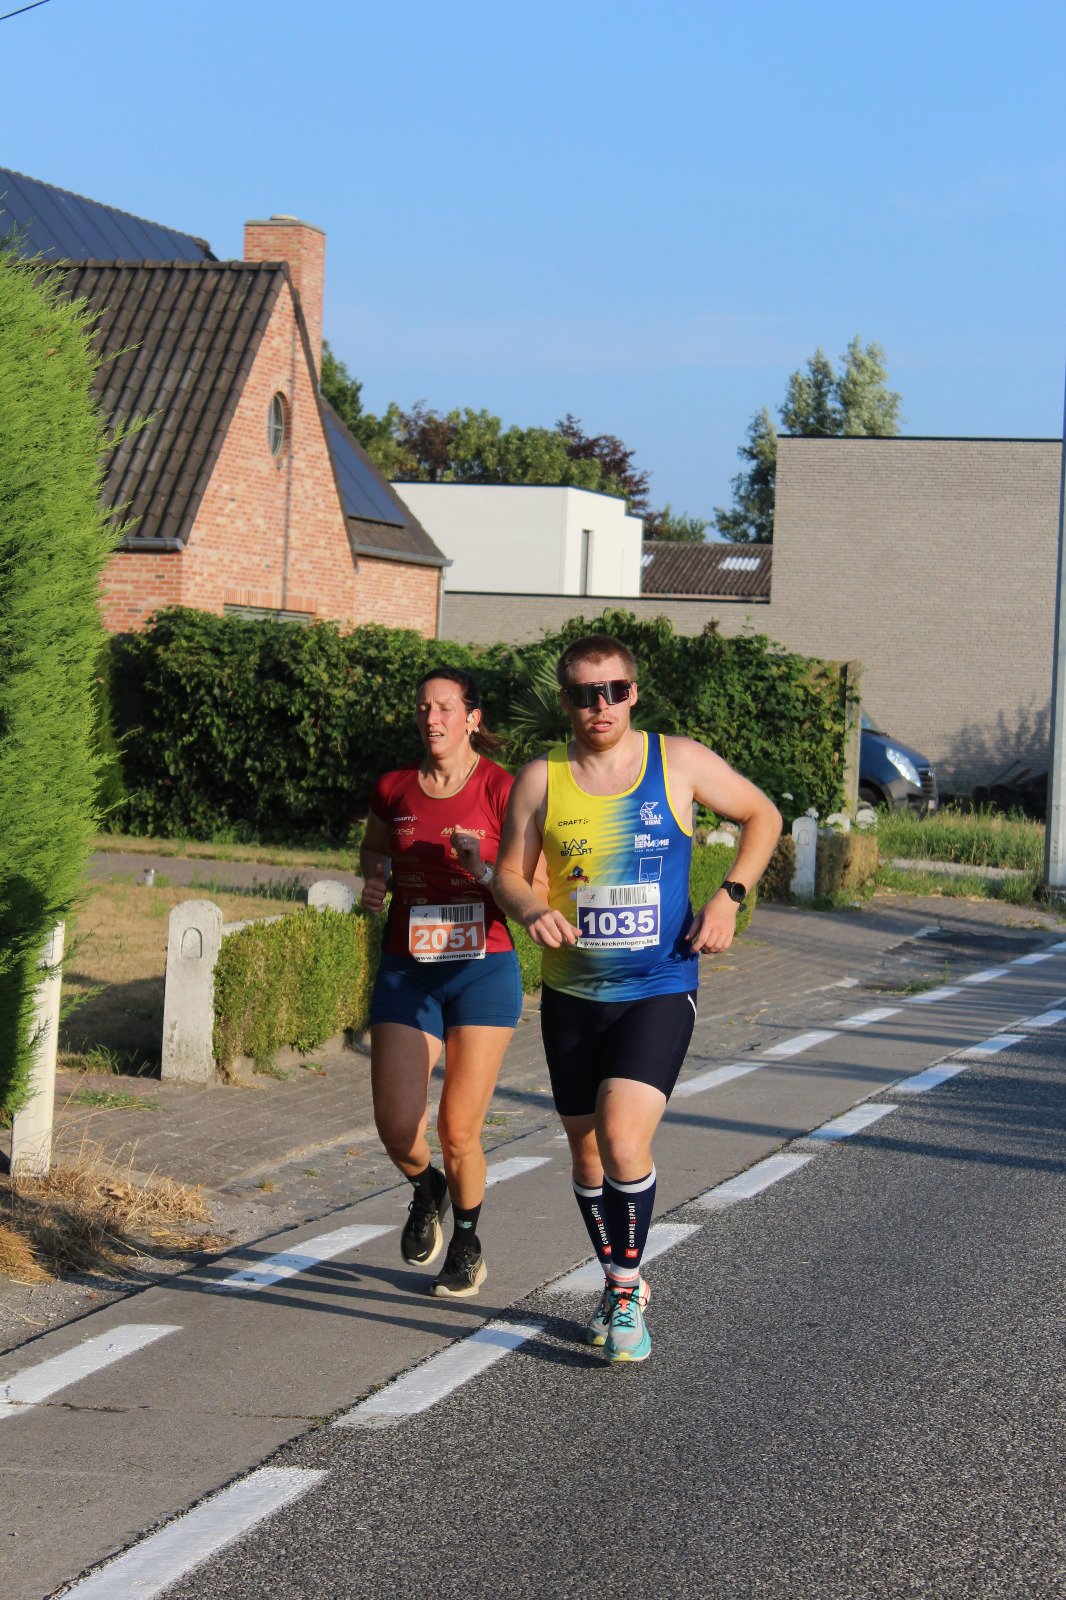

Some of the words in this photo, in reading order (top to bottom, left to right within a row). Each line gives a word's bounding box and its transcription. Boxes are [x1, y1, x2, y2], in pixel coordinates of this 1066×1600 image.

[558, 819, 583, 827] CRAFT
[583, 910, 655, 935] 1035
[414, 926, 478, 950] 2051
[584, 938, 654, 947] www.krekenlopers.be
